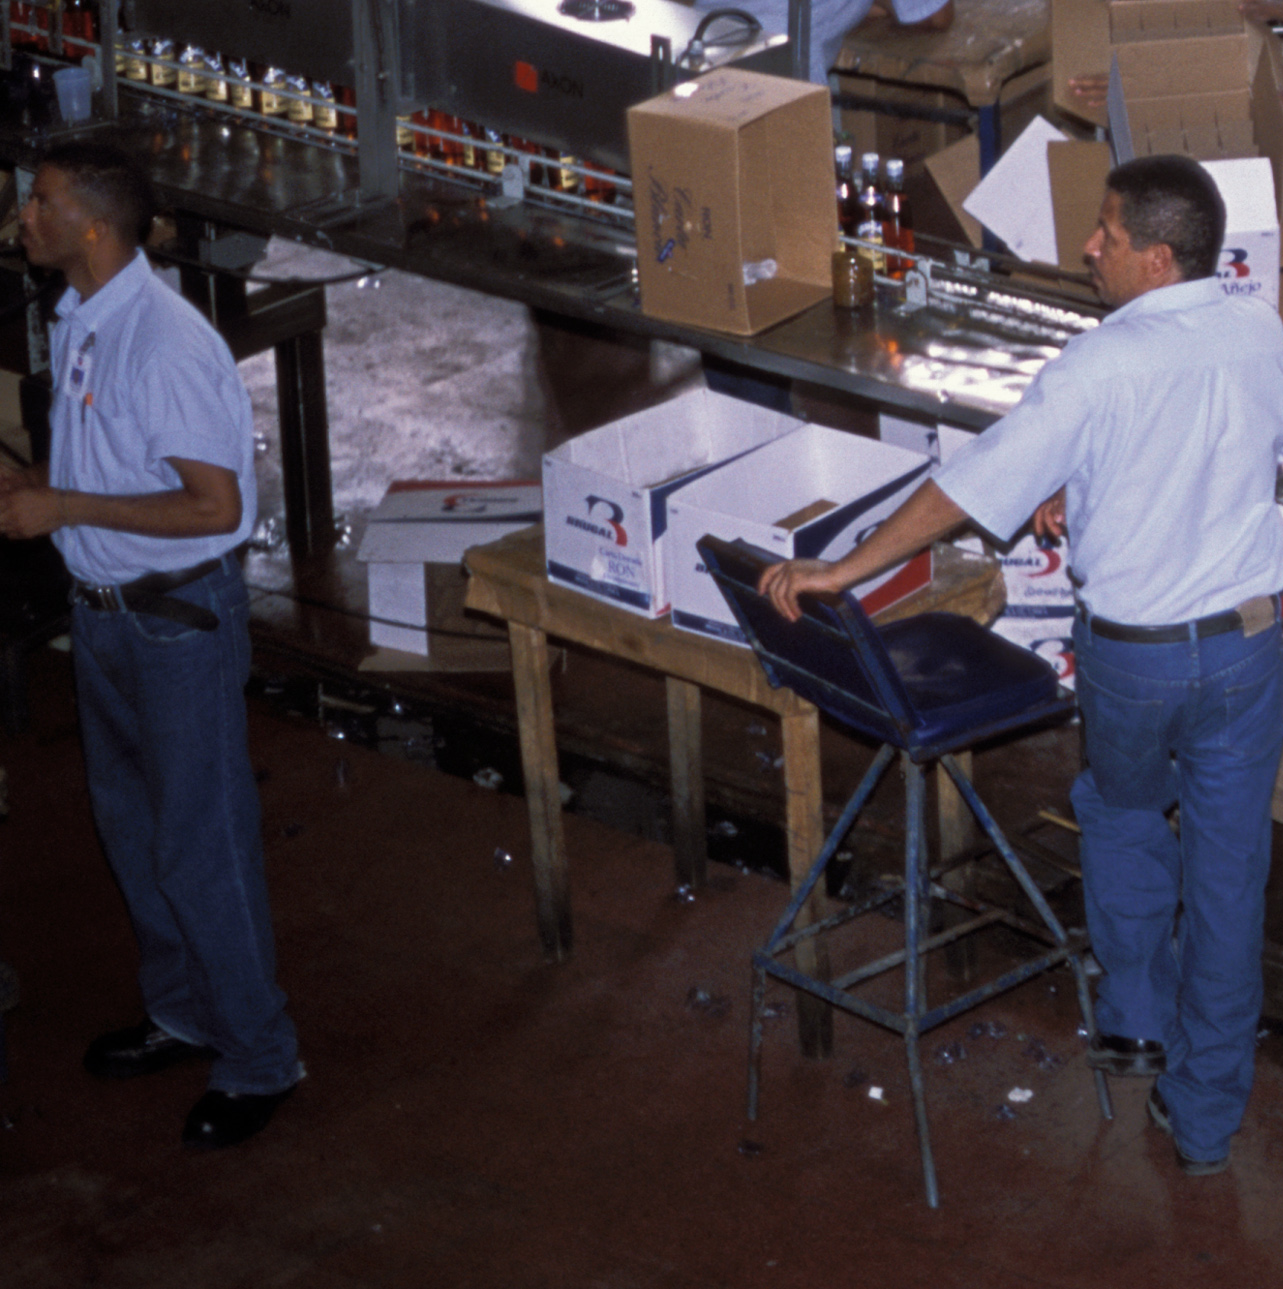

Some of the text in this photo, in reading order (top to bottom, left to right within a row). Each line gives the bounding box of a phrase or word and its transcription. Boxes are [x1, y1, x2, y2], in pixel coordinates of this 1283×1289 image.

[1220, 281, 1262, 296] Añejo
[566, 514, 613, 540] BRUGAL
[608, 561, 636, 579] RON
